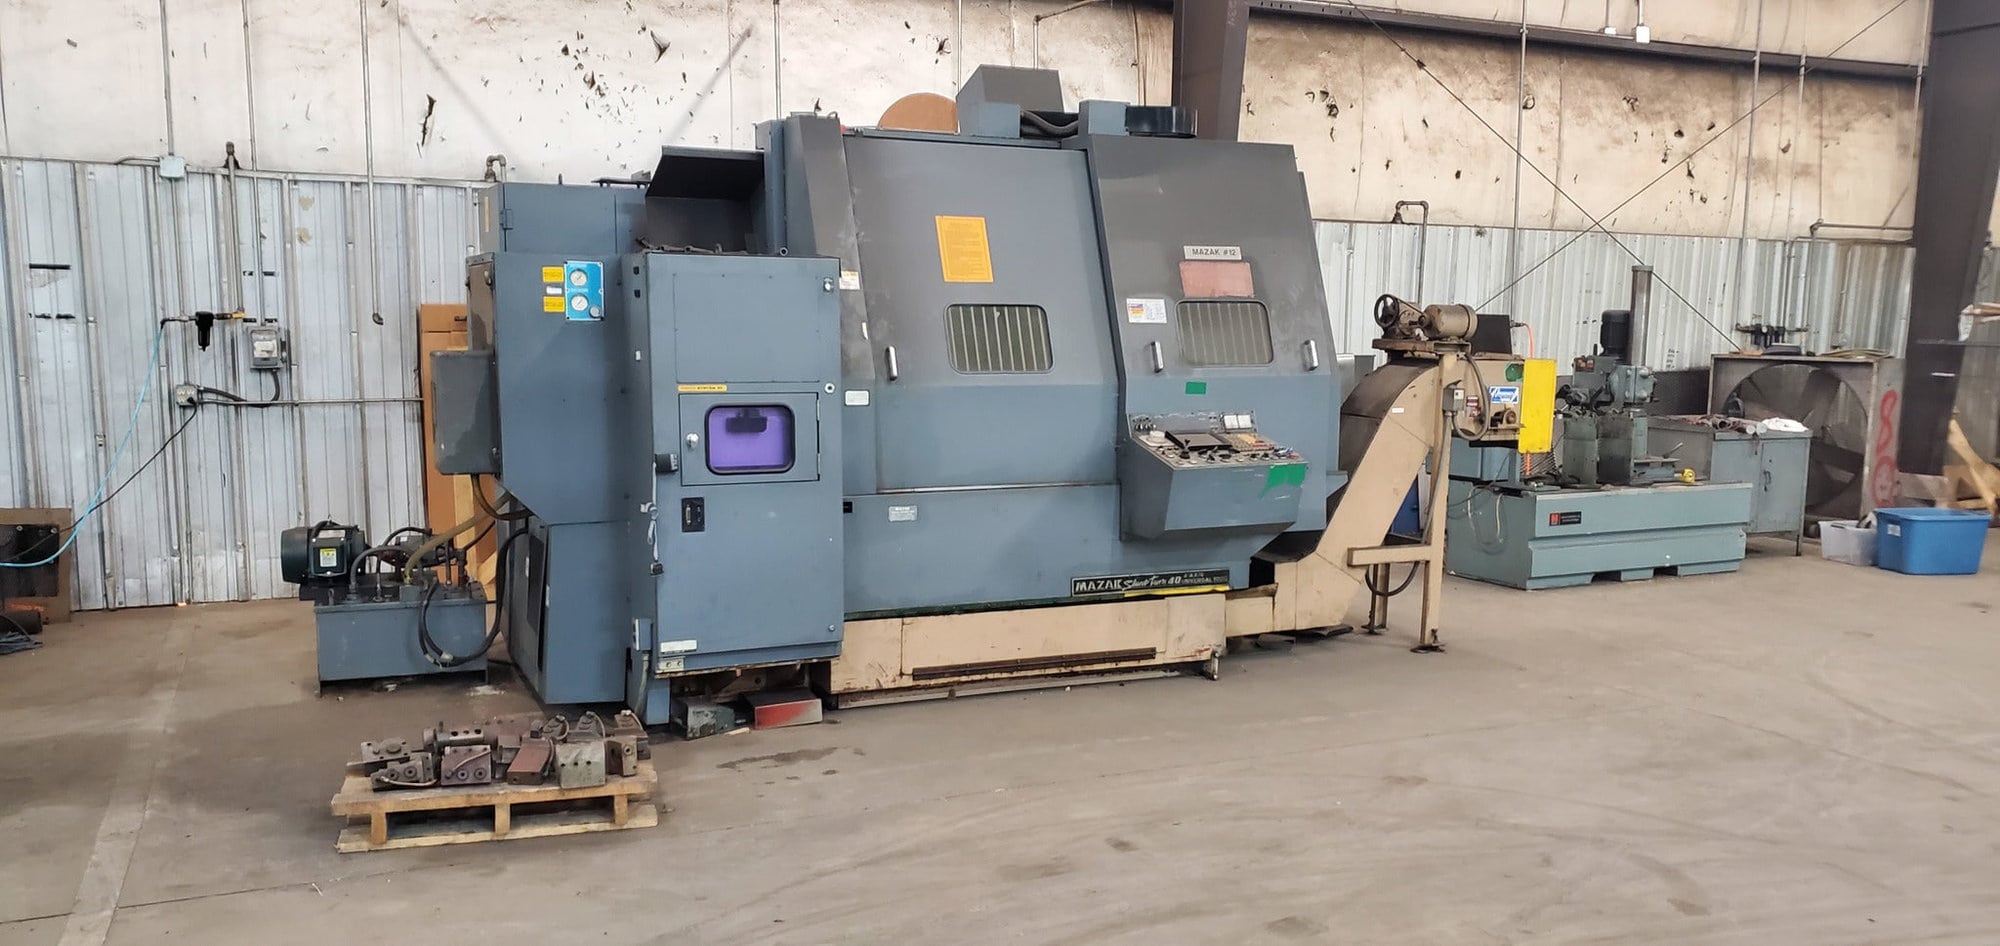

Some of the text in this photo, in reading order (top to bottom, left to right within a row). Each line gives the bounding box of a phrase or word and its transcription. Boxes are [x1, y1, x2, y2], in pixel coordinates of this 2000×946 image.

[1192, 248, 1220, 256] MAZAK
[1075, 579, 1123, 592] MAZAK
[1168, 576, 1182, 585] 40
